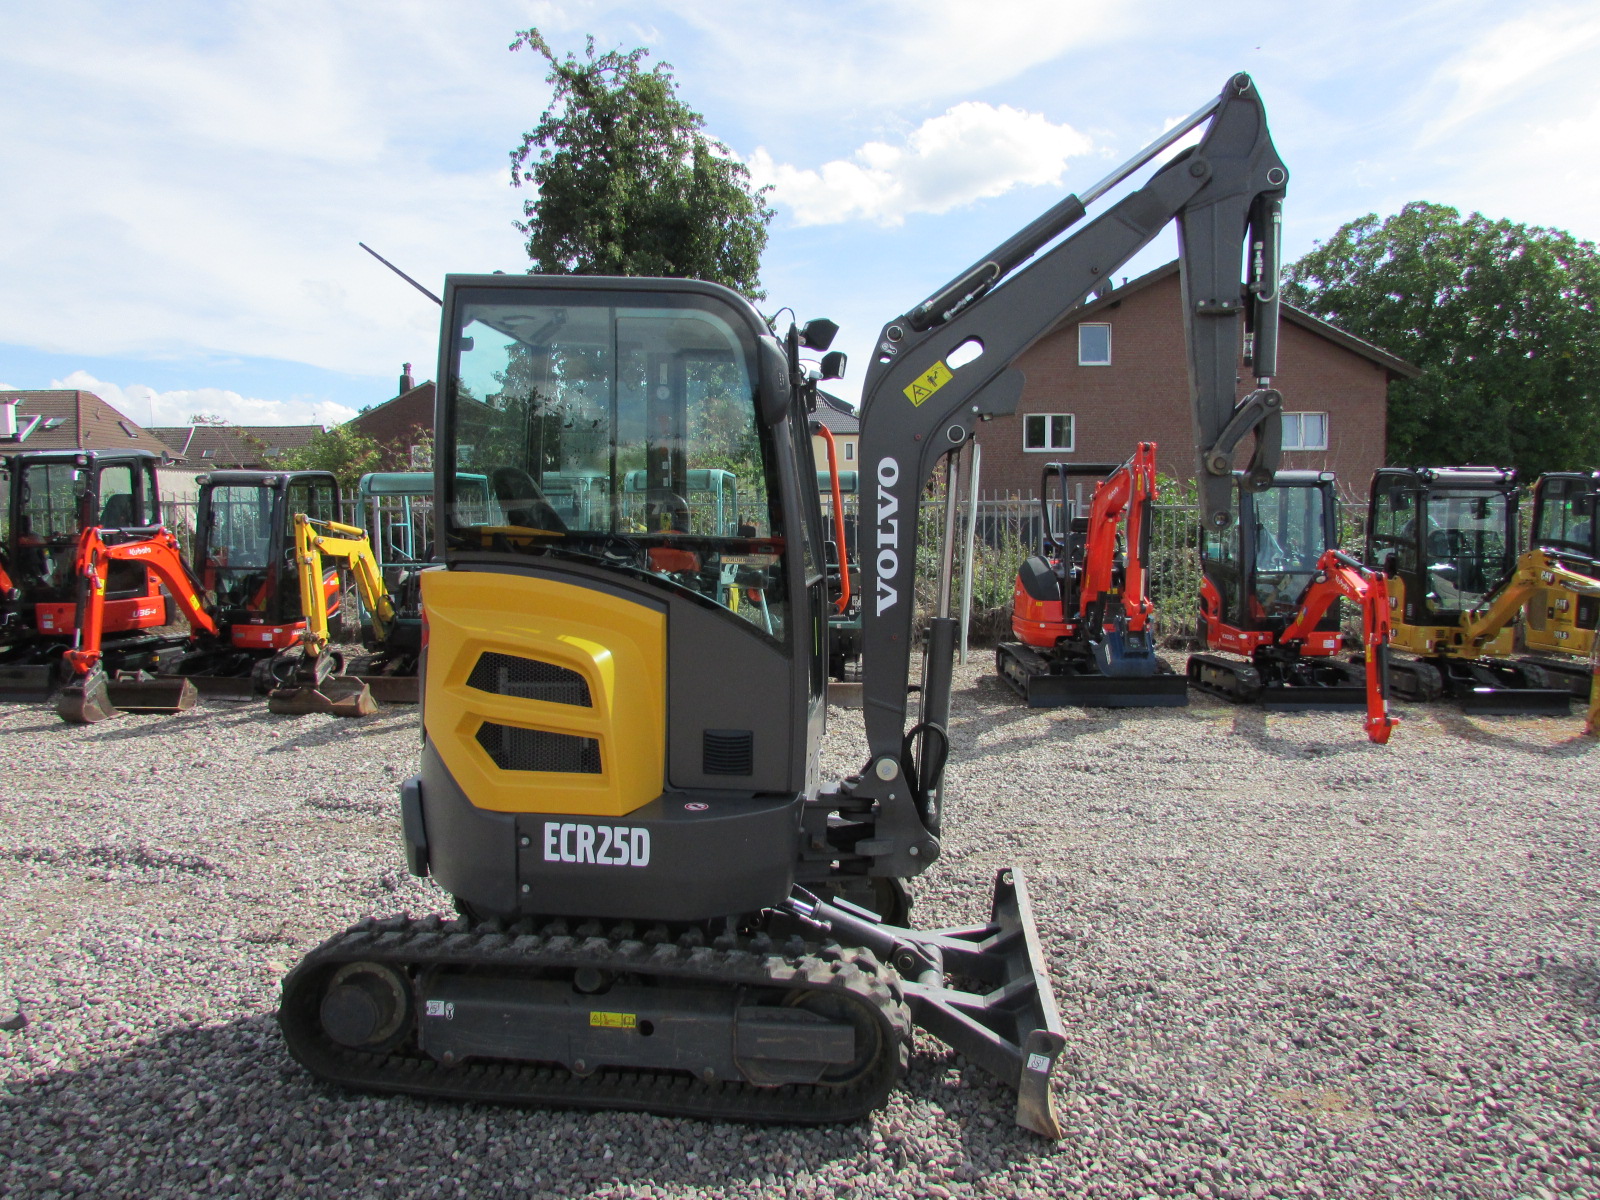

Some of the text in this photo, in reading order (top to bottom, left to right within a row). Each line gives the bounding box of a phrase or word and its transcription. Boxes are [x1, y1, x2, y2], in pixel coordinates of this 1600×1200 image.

[876, 457, 899, 617] VOLVO
[129, 546, 152, 556] Kubota
[1335, 574, 1350, 593] Kubota
[1541, 570, 1553, 582] CAT
[544, 821, 651, 867] ECR25D
